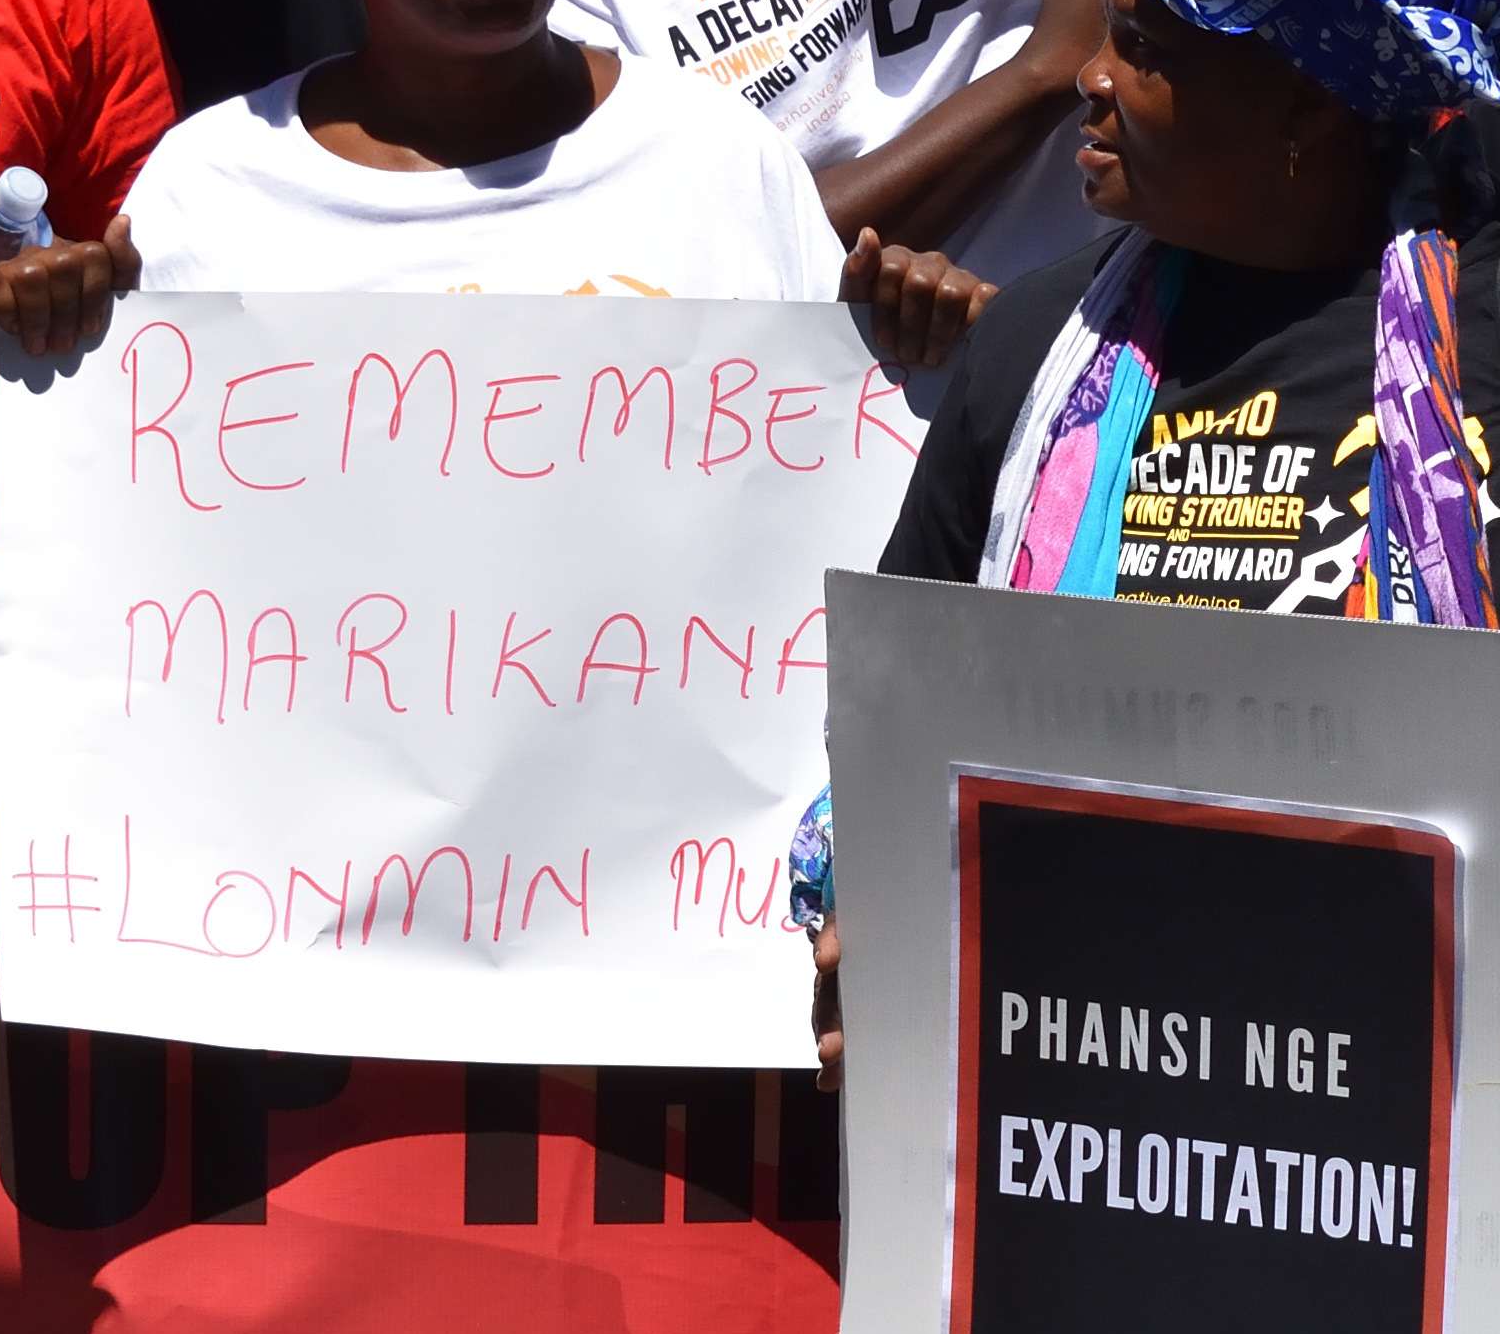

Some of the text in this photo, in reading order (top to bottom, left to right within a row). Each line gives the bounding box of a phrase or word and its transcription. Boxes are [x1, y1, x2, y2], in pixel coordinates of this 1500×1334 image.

[667, 24, 702, 68] A
[121, 320, 921, 512] REMEMBER
[1262, 444, 1316, 494] OF
[1166, 527, 1191, 543] AND
[1179, 495, 1305, 530] STRONGER
[1161, 545, 1294, 582] FORWARD
[999, 989, 1352, 1098] PHANSI NGE
[998, 1114, 1417, 1249] EXPLOITATION!
